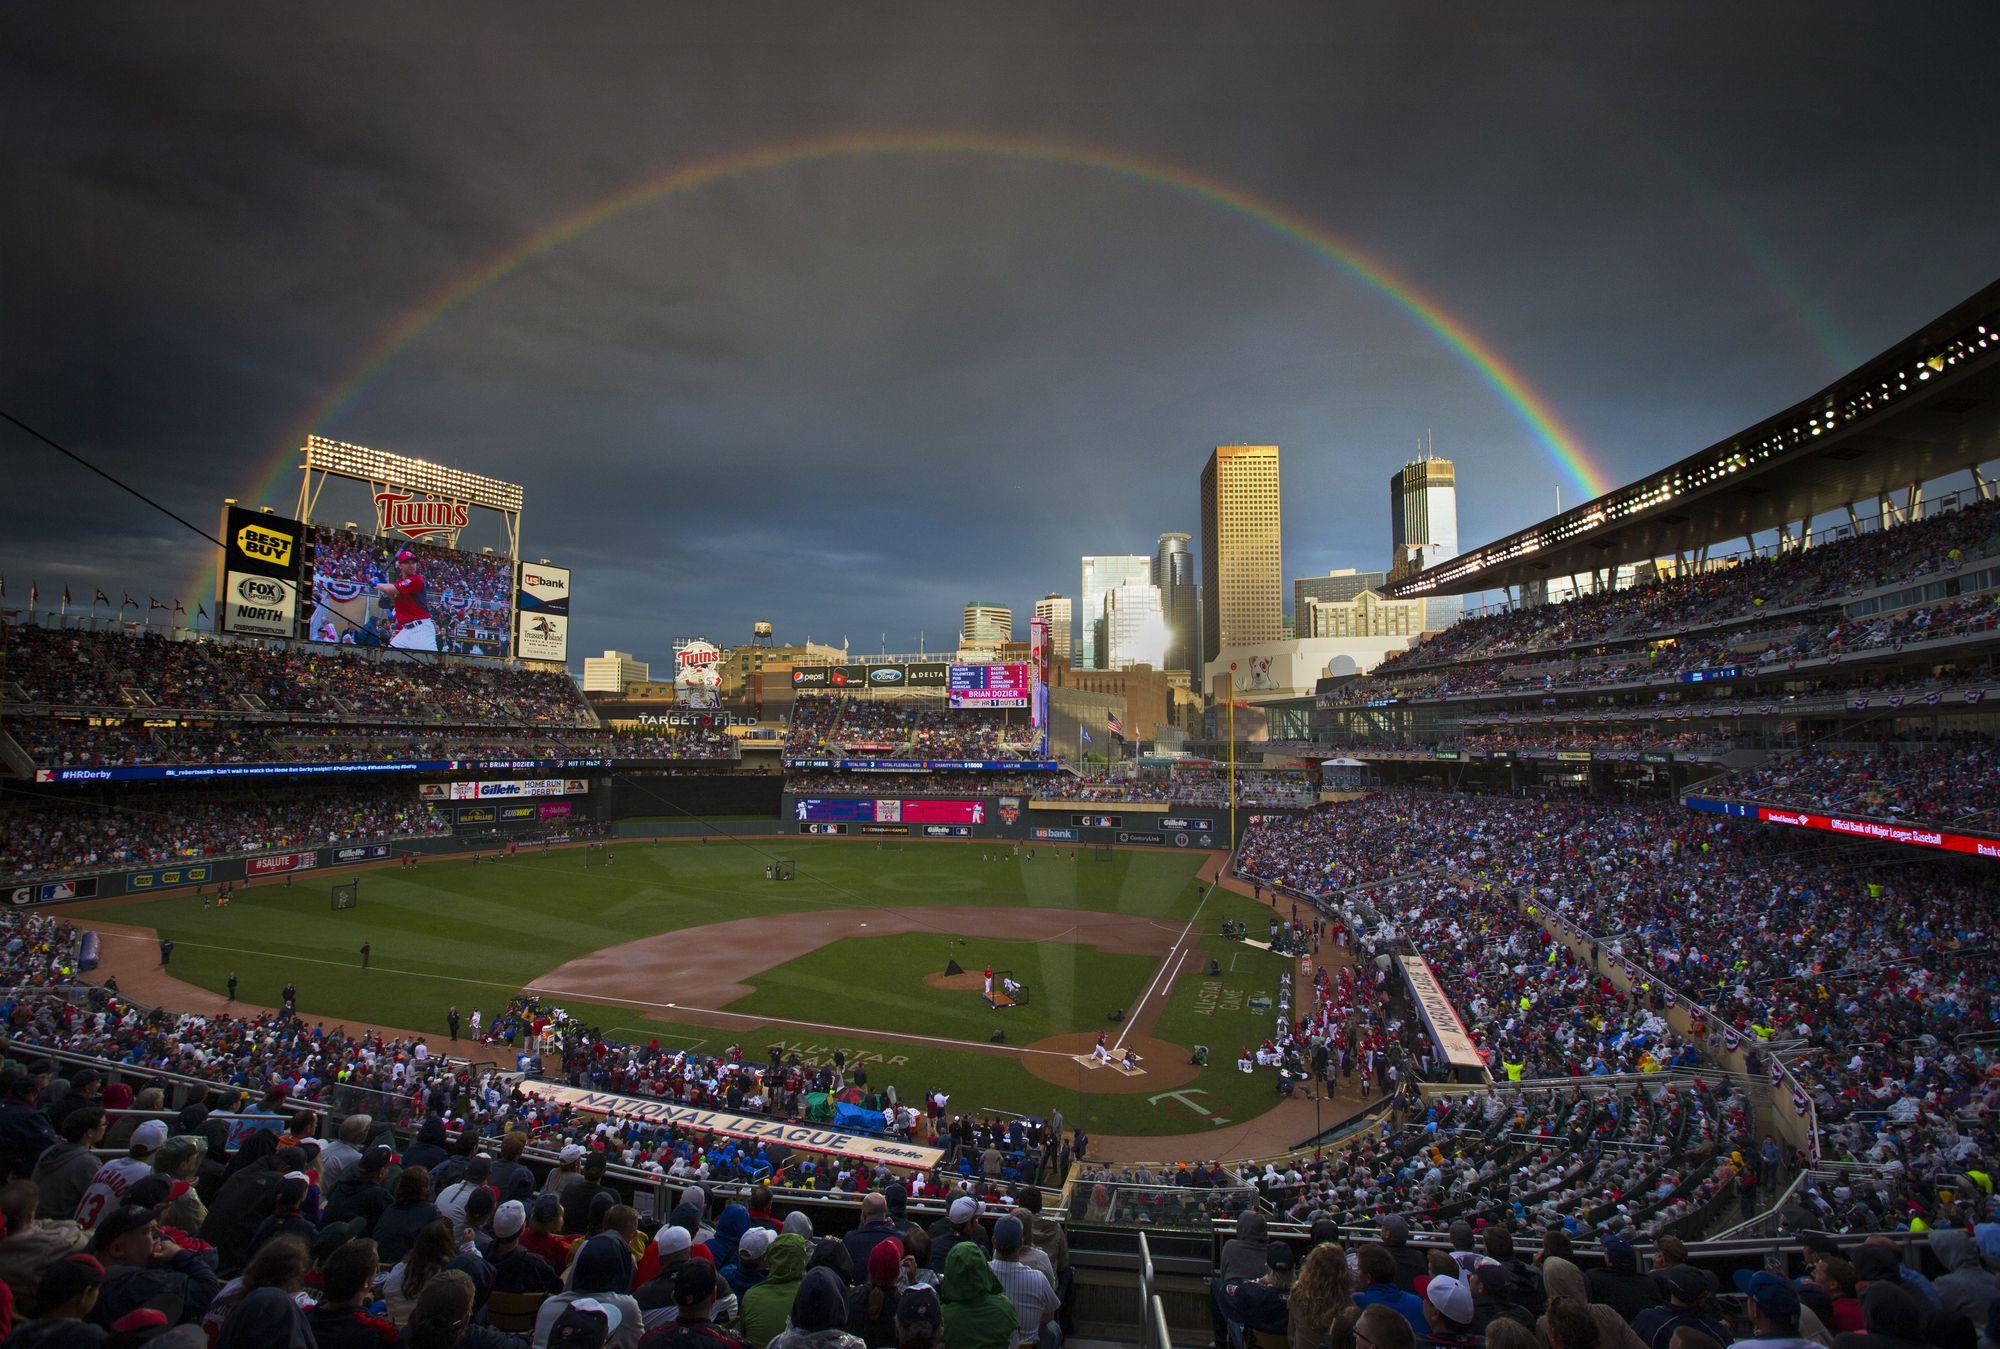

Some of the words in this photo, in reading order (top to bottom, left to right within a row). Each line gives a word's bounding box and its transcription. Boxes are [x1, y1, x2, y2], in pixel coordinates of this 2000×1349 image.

[374, 492, 469, 531] Twins
[245, 529, 291, 551] BEST
[245, 540, 287, 560] BUY
[249, 582, 275, 596] FOX
[248, 593, 276, 601] SPORTS
[237, 605, 283, 622] NORTH
[524, 630, 544, 640] Treasure
[548, 633, 563, 642] Island
[677, 650, 719, 666] Twins
[804, 673, 824, 682] pepsi
[876, 671, 895, 681] Ford
[638, 715, 700, 726] TARGET
[714, 717, 758, 726] FIELD
[62, 770, 111, 780] #HRDerby
[480, 784, 521, 796] Gillette
[525, 780, 545, 788] HOME
[532, 788, 555, 796] DERBY
[502, 808, 534, 818] SUBWAY
[1724, 803, 1728, 813] 1
[1740, 805, 1745, 815] 5
[1163, 819, 1188, 828] Gillette
[927, 826, 949, 834] Gillette
[1831, 819, 1850, 830] Official
[1850, 821, 1865, 832] Bank
[1865, 823, 1871, 833] of
[1872, 824, 1889, 838] Major
[1890, 826, 1912, 841] League
[1913, 830, 1942, 845] Baseball
[1130, 833, 1161, 842] CenturyLink
[339, 849, 365, 859] Gillette
[1977, 843, 1997, 857] Bank
[256, 856, 290, 868] #SALUTE
[1409, 971, 1440, 993] LEAGUE
[1420, 993, 1462, 1034] AMERICAN
[766, 1040, 818, 1054] ALL
[576, 1093, 715, 1128] NATIONAL
[721, 1116, 855, 1150] LEAGUE
[872, 1145, 924, 1160] Gillette
[73, 1190, 105, 1229] 13
